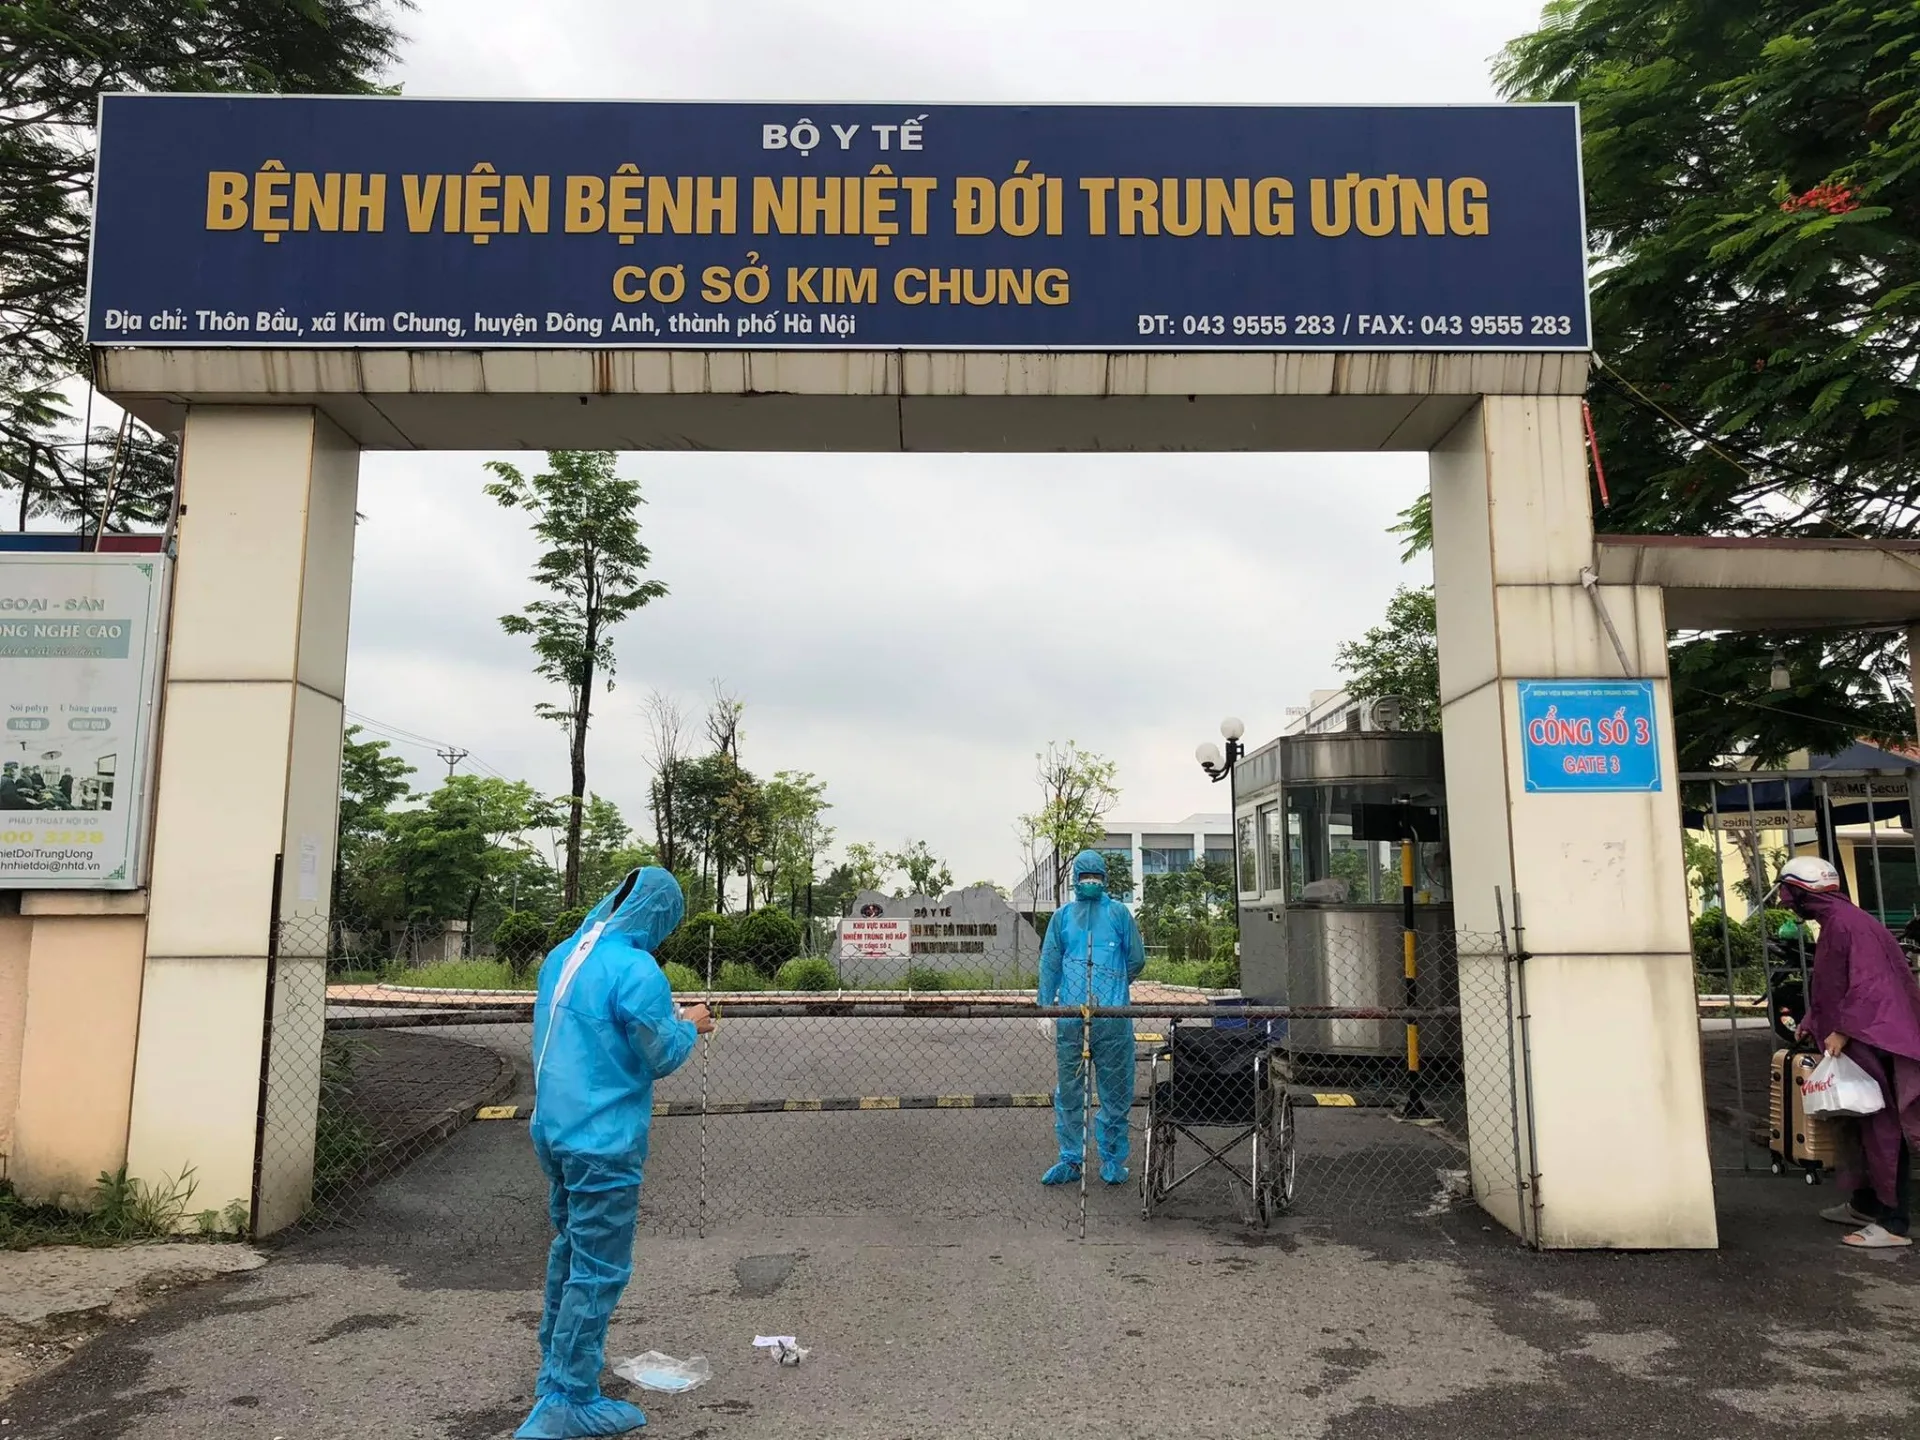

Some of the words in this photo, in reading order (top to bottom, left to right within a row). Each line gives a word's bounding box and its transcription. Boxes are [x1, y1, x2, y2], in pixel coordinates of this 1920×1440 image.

[762, 117, 821, 157] BỘ
[830, 124, 860, 150] Y
[871, 114, 929, 151] TẾ
[205, 159, 387, 243] BỆNH
[401, 162, 550, 245] VIỆN
[564, 163, 737, 245] BỆNH
[752, 164, 938, 246] NHIỆT
[952, 159, 1063, 237] ĐỚI
[1079, 176, 1295, 237] TRUNG
[1310, 172, 1489, 237] ƯƠNG
[612, 263, 686, 303] CƠ
[700, 250, 770, 304] SỞ
[787, 267, 878, 304] KIM
[893, 267, 1070, 305] CHUNG
[104, 309, 143, 335] Địa
[149, 307, 188, 331] chỉ:
[195, 310, 250, 331] Thôn
[255, 307, 304, 337] Bầu,
[310, 311, 336, 332] xã
[343, 311, 386, 332] Kim
[392, 311, 467, 338] Chung,
[474, 312, 538, 337] huyện
[545, 312, 603, 338] Đông
[610, 312, 661, 337] Anh,
[668, 312, 730, 333] thành
[737, 310, 780, 338] phố
[783, 310, 813, 334] Hà
[819, 311, 856, 339] Nội
[1137, 314, 1175, 335] ĐT:
[1182, 315, 1225, 335] 043
[1232, 315, 1287, 335] 9555
[1294, 315, 1336, 335] 283
[1342, 313, 1351, 336] /
[1358, 314, 1414, 335] FAX:
[1420, 315, 1463, 335] 043
[1470, 315, 1524, 335] 9555
[1530, 315, 1572, 335] 283
[85, 624, 122, 639] CAO
[1529, 704, 1593, 746] CỔNG
[1597, 706, 1629, 746] SỐ
[1634, 717, 1650, 745] 3
[1563, 755, 1607, 774] GATE
[1610, 755, 1620, 774] 3
